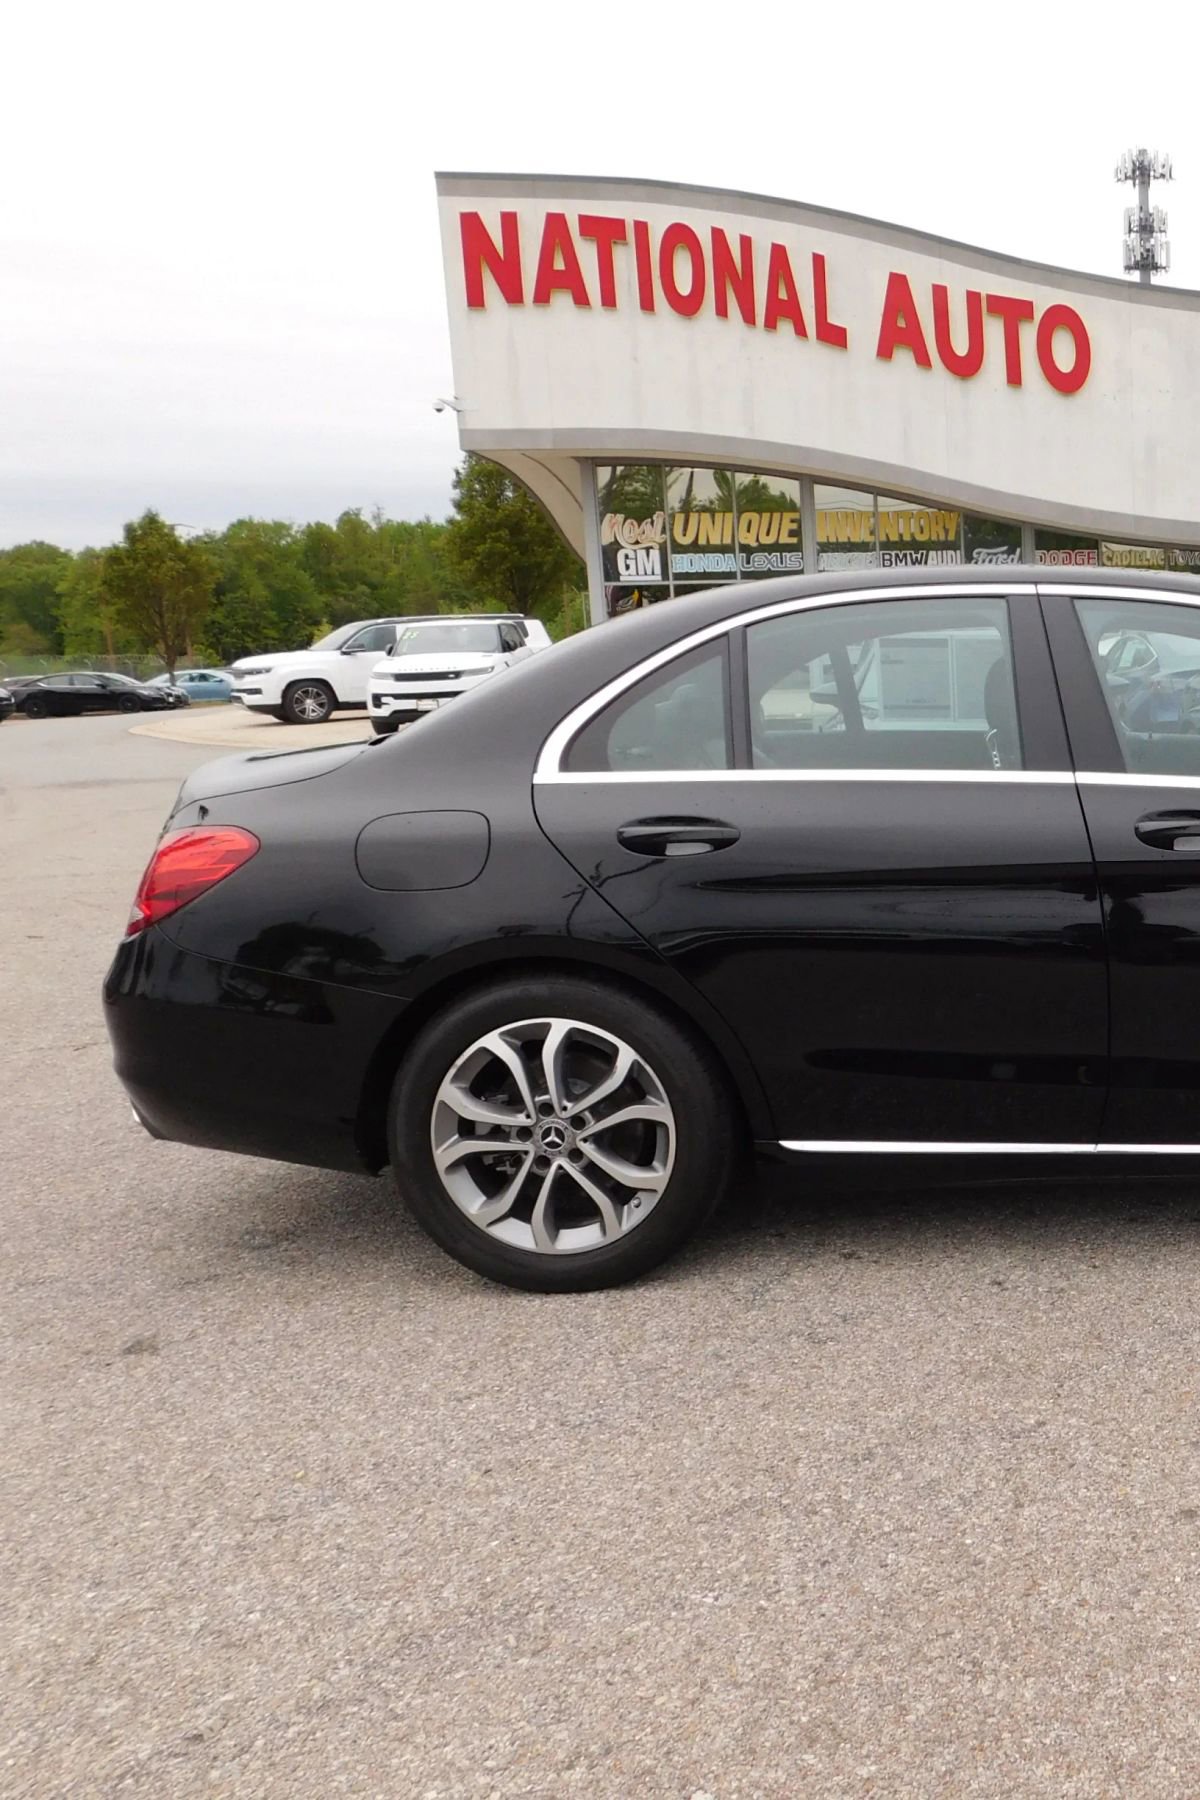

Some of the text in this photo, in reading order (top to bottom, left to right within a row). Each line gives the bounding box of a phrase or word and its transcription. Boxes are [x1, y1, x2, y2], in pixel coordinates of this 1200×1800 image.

[459, 211, 1091, 394] NATIONAL AUTO
[673, 512, 800, 547] UNIQUE
[815, 511, 961, 542] INVENTORY
[617, 548, 661, 577] GM
[672, 553, 737, 573] HONDA
[740, 552, 803, 571] LEXUS
[880, 551, 928, 568] BMW
[926, 550, 961, 567] AUDI
[971, 546, 1025, 565] Ford
[1035, 550, 1098, 566] DODGE
[1103, 549, 1165, 567] CADILLAC
